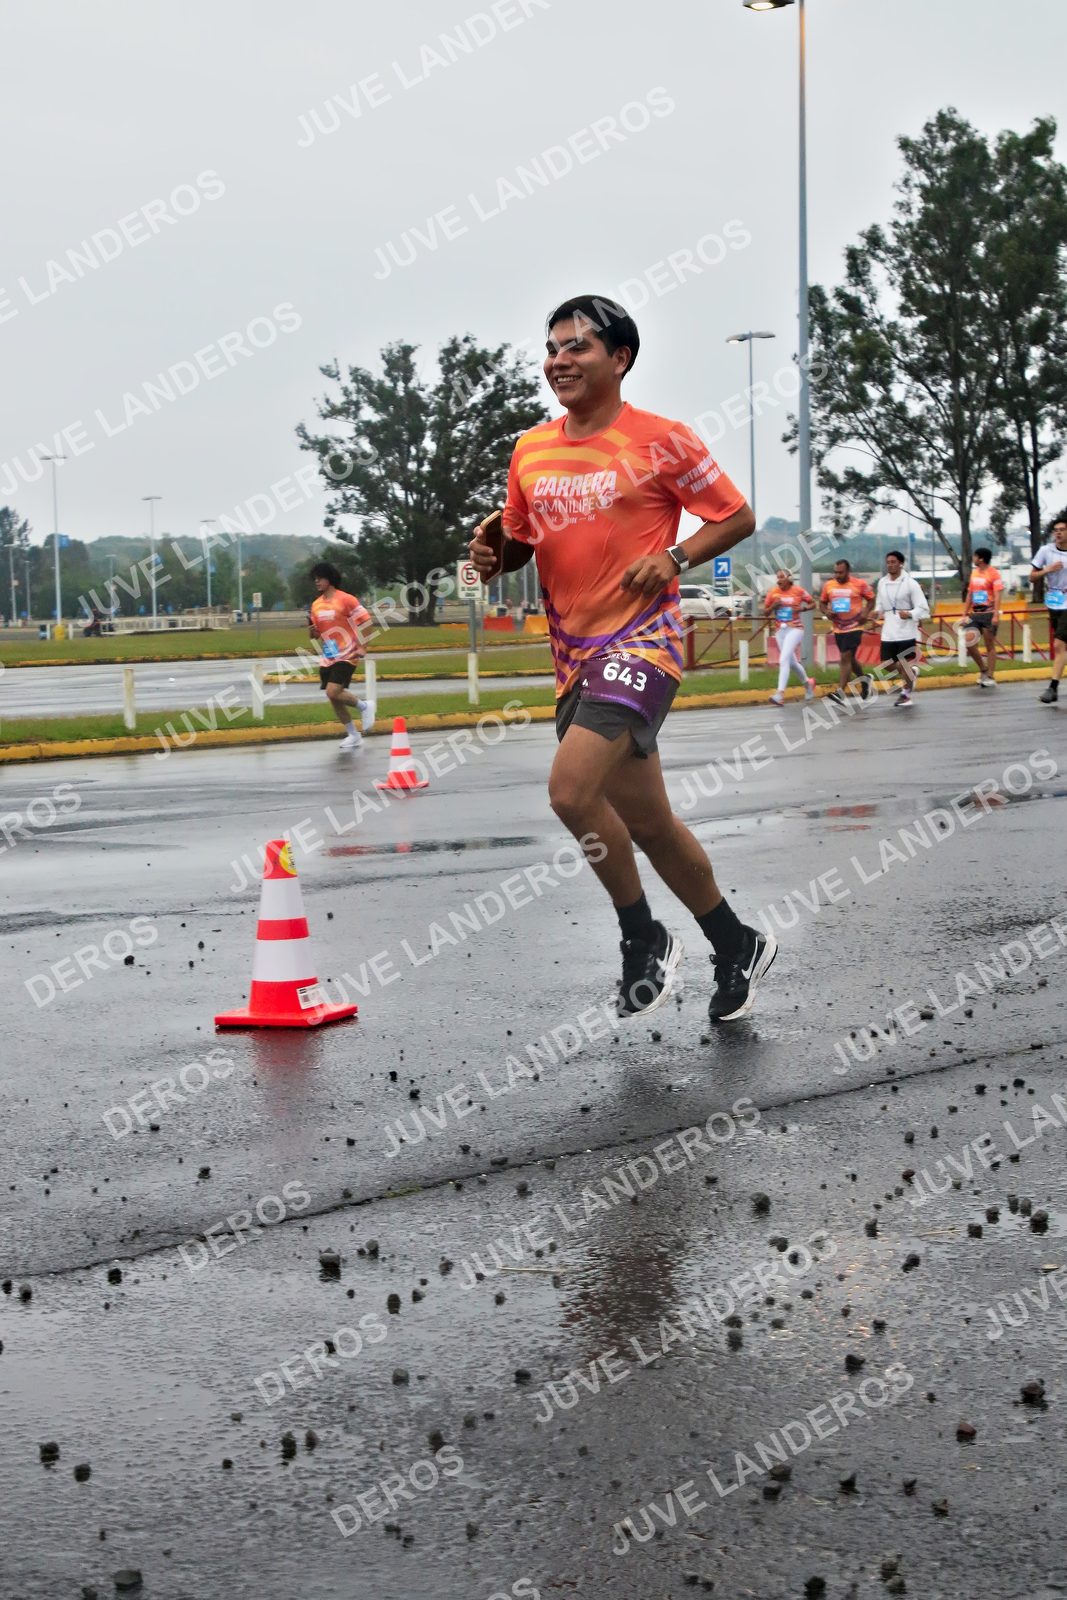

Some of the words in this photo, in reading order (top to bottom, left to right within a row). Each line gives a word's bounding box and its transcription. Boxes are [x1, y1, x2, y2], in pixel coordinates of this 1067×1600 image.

[533, 470, 618, 497] CARRERA
[532, 496, 596, 513] OMNILIFE
[602, 661, 648, 692] 643
